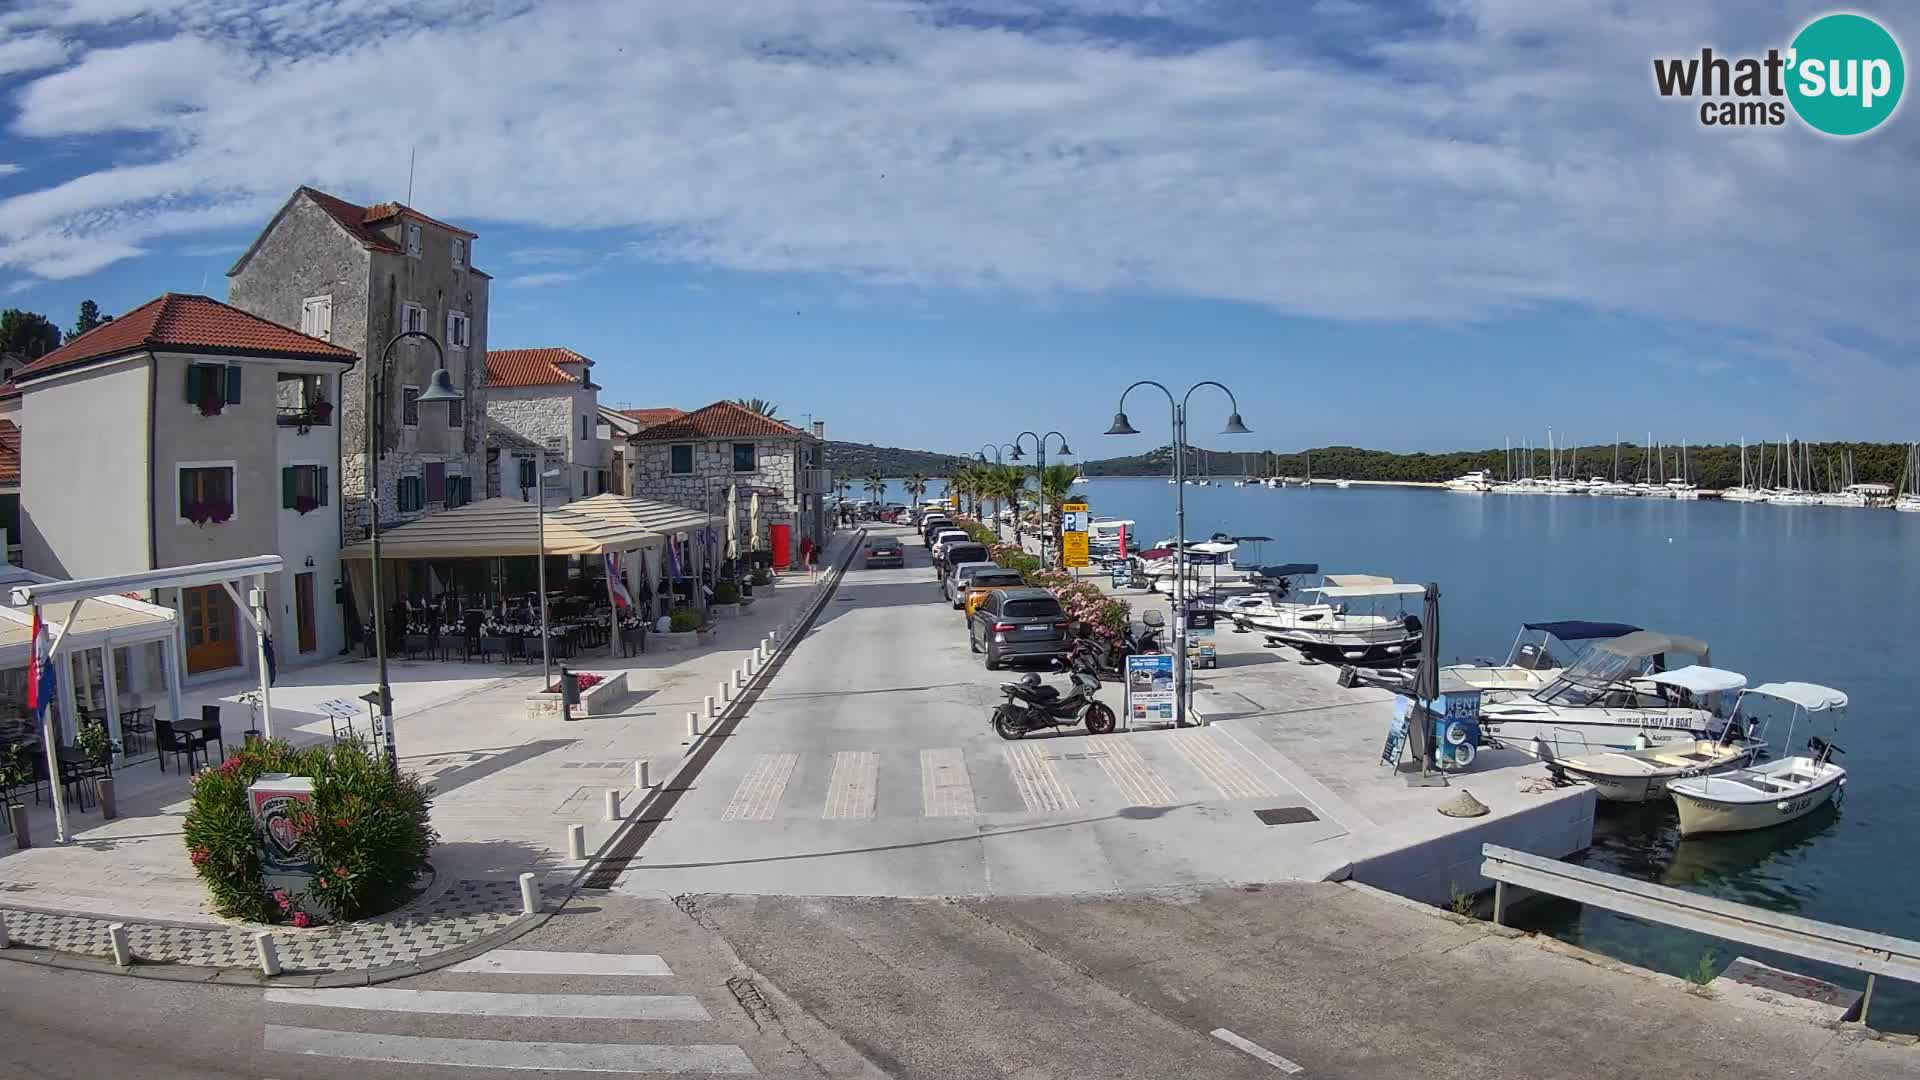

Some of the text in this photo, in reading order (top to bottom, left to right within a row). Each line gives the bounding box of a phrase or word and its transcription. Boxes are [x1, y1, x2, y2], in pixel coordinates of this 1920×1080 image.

[1447, 696, 1478, 709] RENT
[1447, 709, 1478, 718] A BOAT
[1669, 717, 1674, 727] A
[1676, 717, 1692, 728] BOAT
